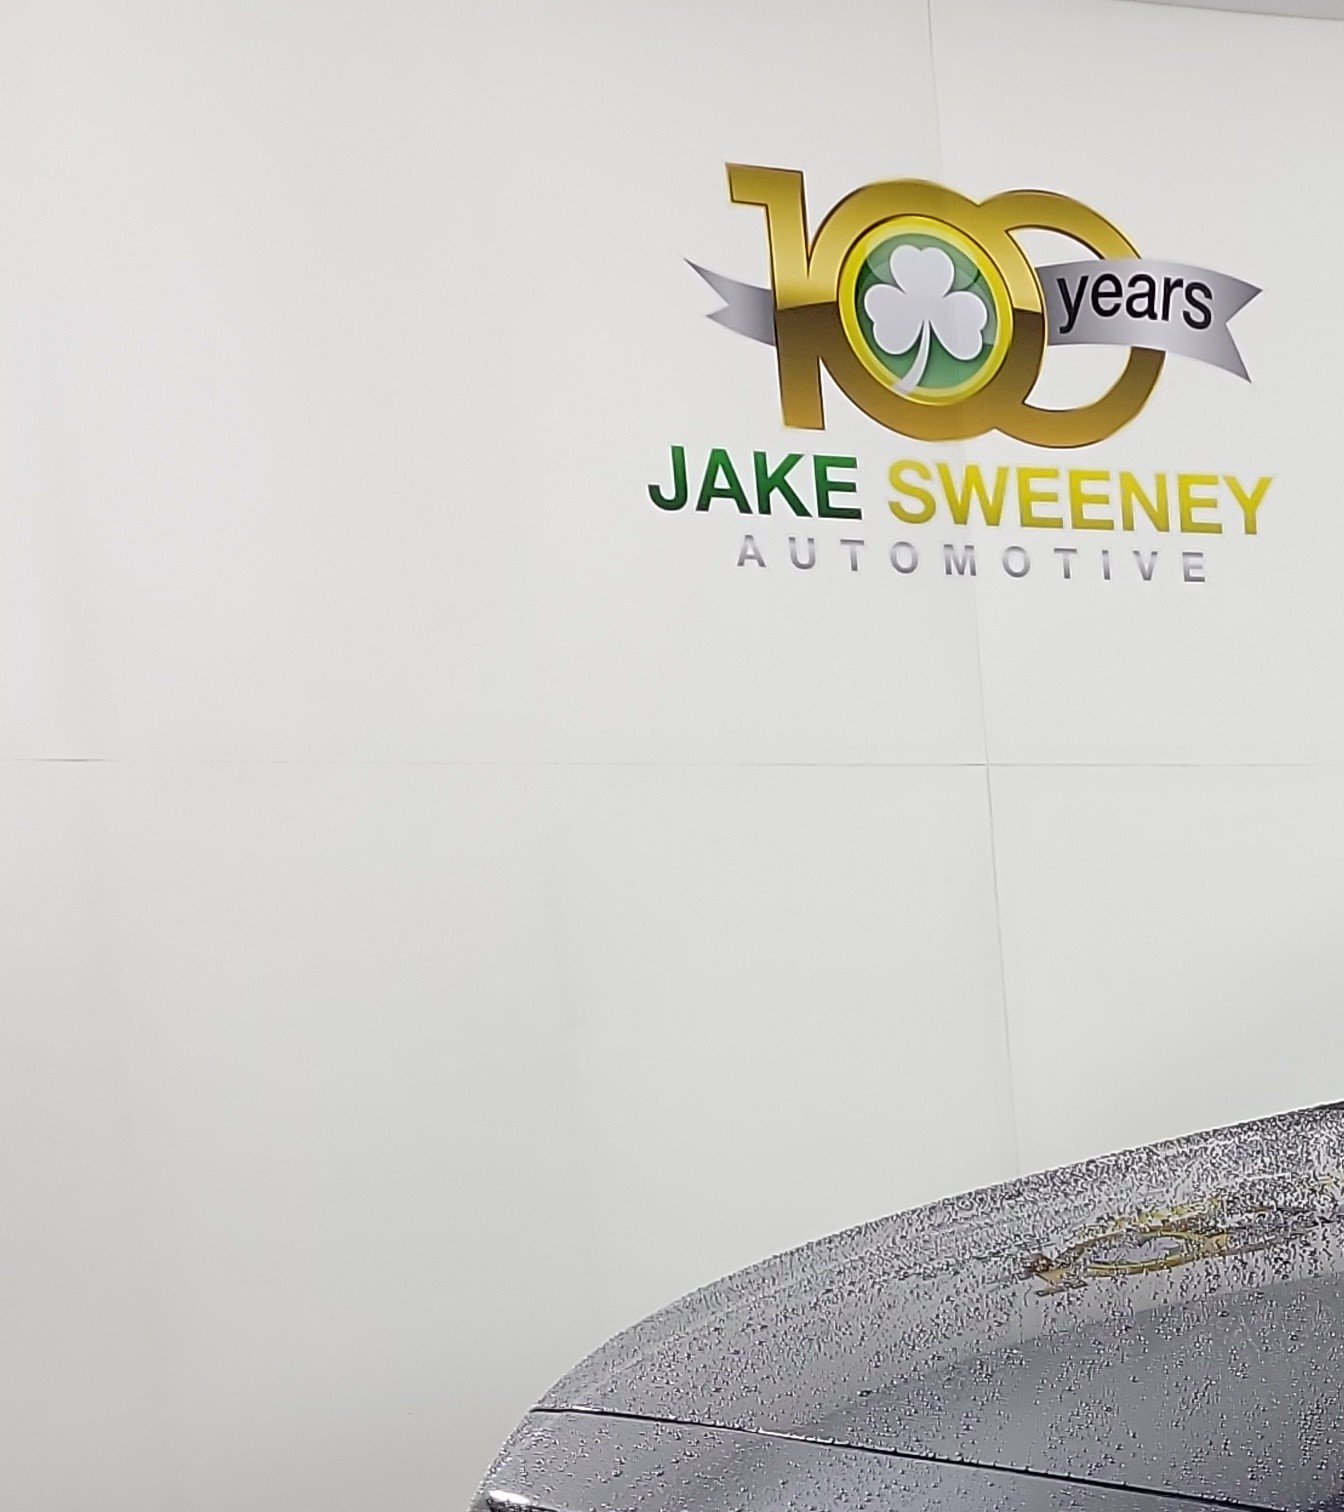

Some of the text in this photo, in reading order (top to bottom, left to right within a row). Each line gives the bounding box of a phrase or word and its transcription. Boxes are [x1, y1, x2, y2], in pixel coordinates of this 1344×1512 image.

[724, 161, 1214, 449] 100 years
[647, 445, 1274, 536] JAKE SWEENEY
[736, 533, 1208, 584] AUTOMOTIVE
